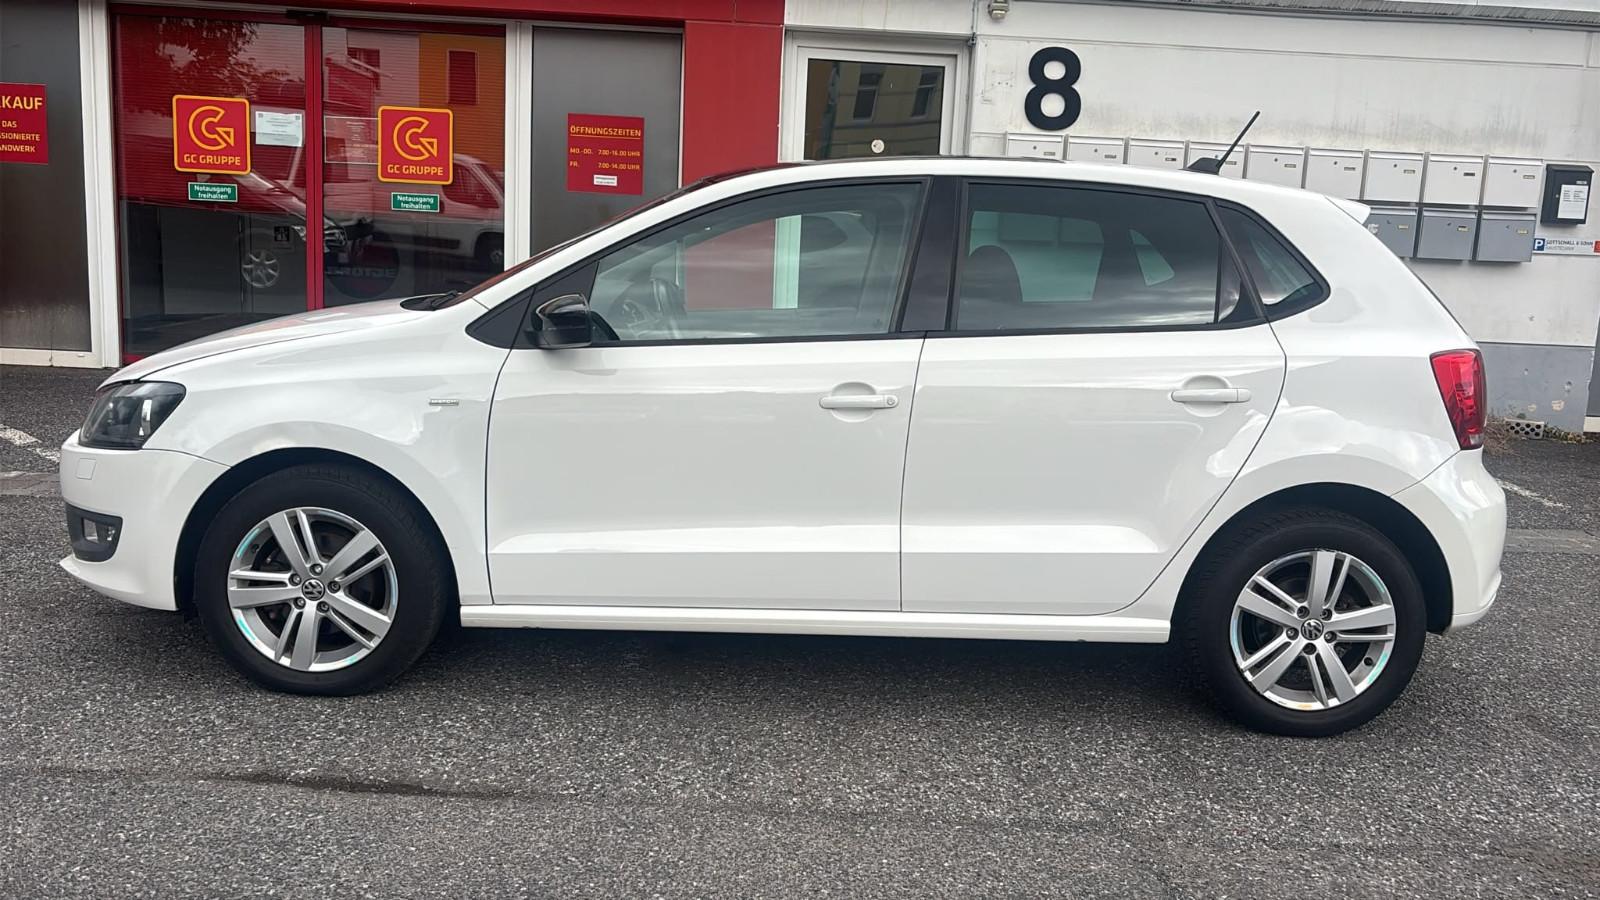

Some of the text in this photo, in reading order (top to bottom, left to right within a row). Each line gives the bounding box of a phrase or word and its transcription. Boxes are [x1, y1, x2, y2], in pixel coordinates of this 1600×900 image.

[1025, 46, 1081, 130] 8
[0, 95, 43, 110] KAUF
[2, 120, 17, 128] DAS
[570, 125, 641, 136] ÖFFNUNGSZEITEN
[183, 154, 241, 166] GC GRUPPE
[387, 164, 444, 176] GC GRUPPE
[194, 184, 232, 194] Notausgang
[198, 192, 229, 200] freihalten
[397, 194, 434, 204] Notausgang
[401, 202, 431, 210] freihalten
[1534, 239, 1544, 250] P
